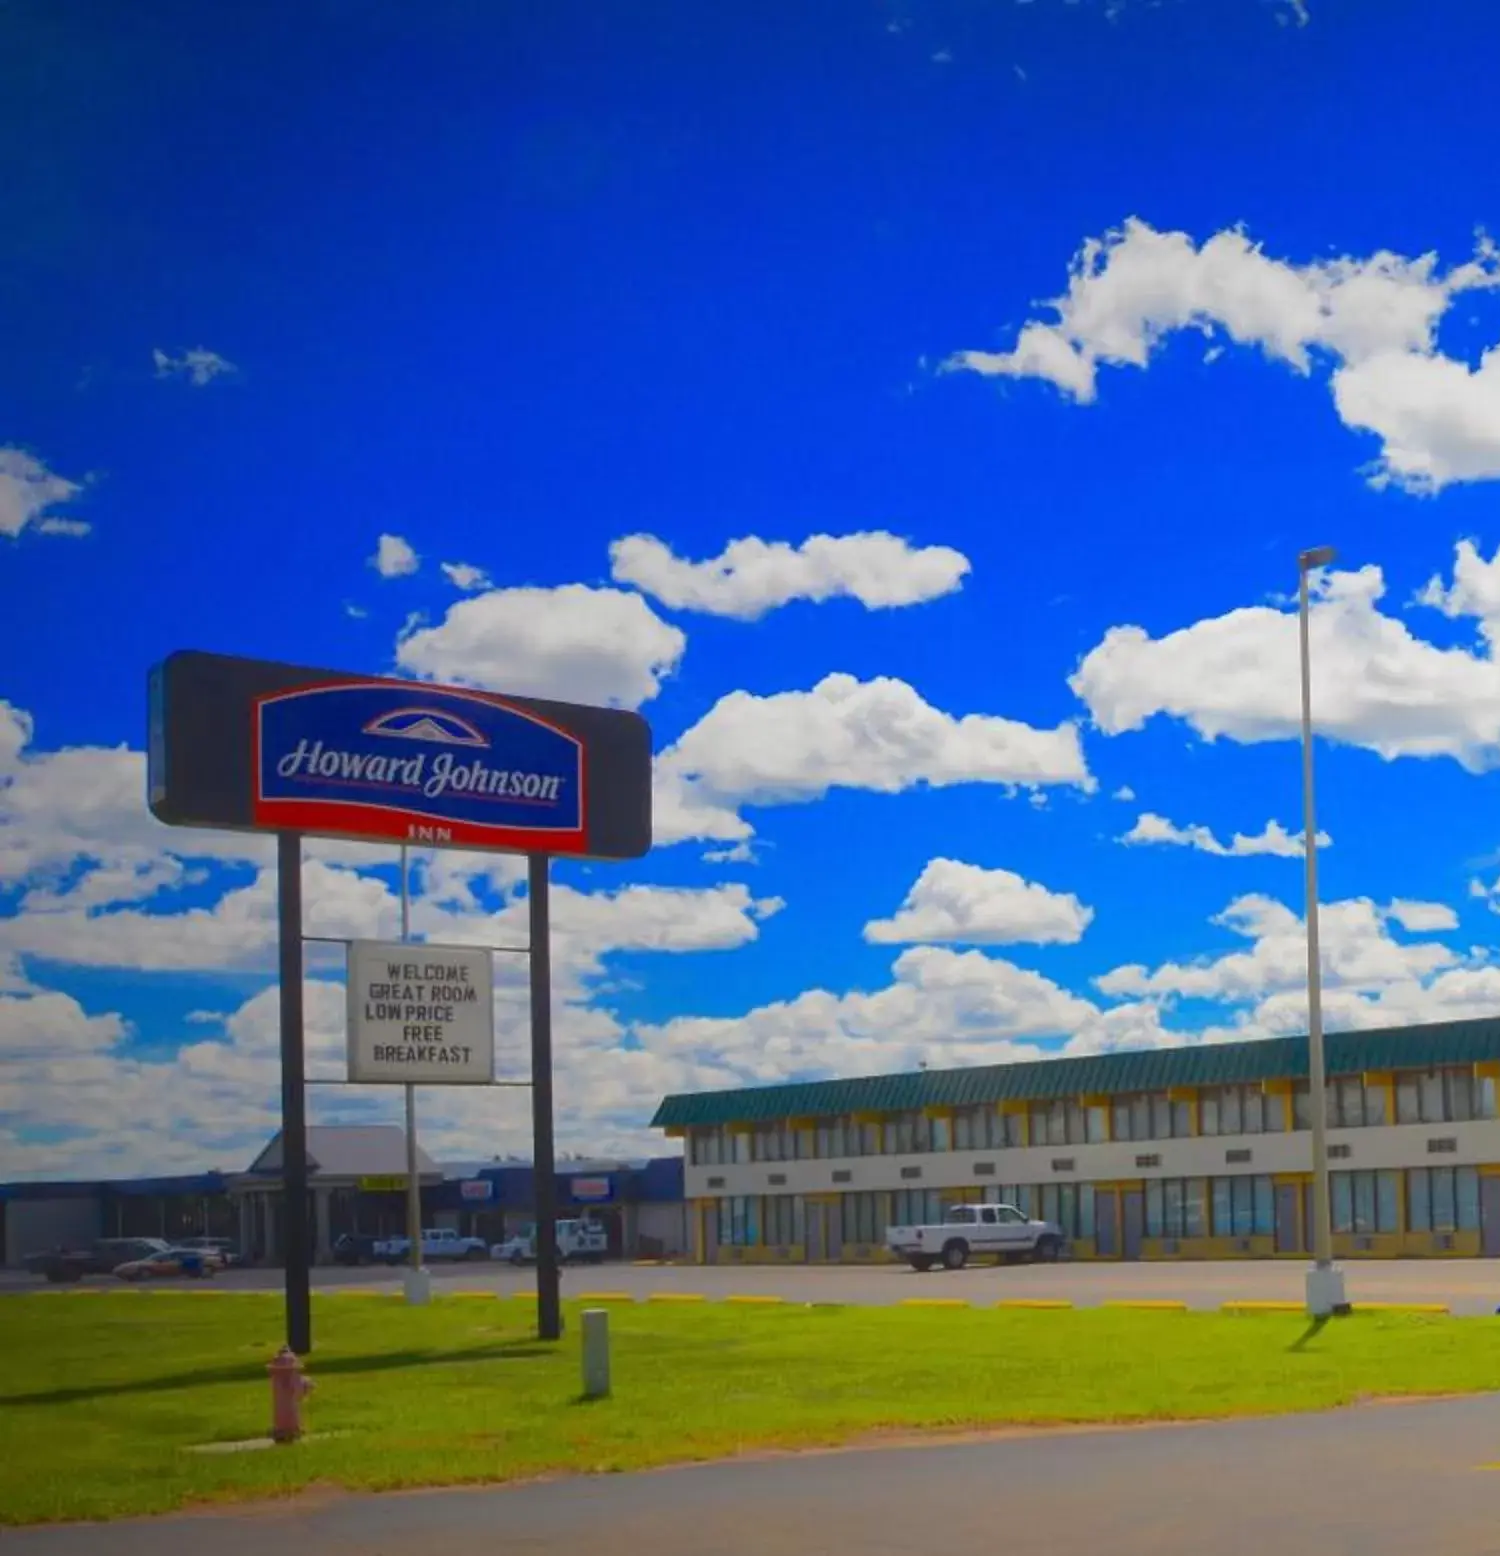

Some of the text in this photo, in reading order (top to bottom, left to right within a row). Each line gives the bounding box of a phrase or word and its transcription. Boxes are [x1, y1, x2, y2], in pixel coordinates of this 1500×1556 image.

[277, 739, 561, 798] Howard Johnson
[407, 823, 452, 840] INN
[387, 963, 469, 982] WELCOME
[369, 983, 477, 1003] GREAT ROOM
[365, 1003, 454, 1022] LOW PRICE
[403, 1025, 443, 1042] FREE
[373, 1045, 472, 1064] BREAKFAST
